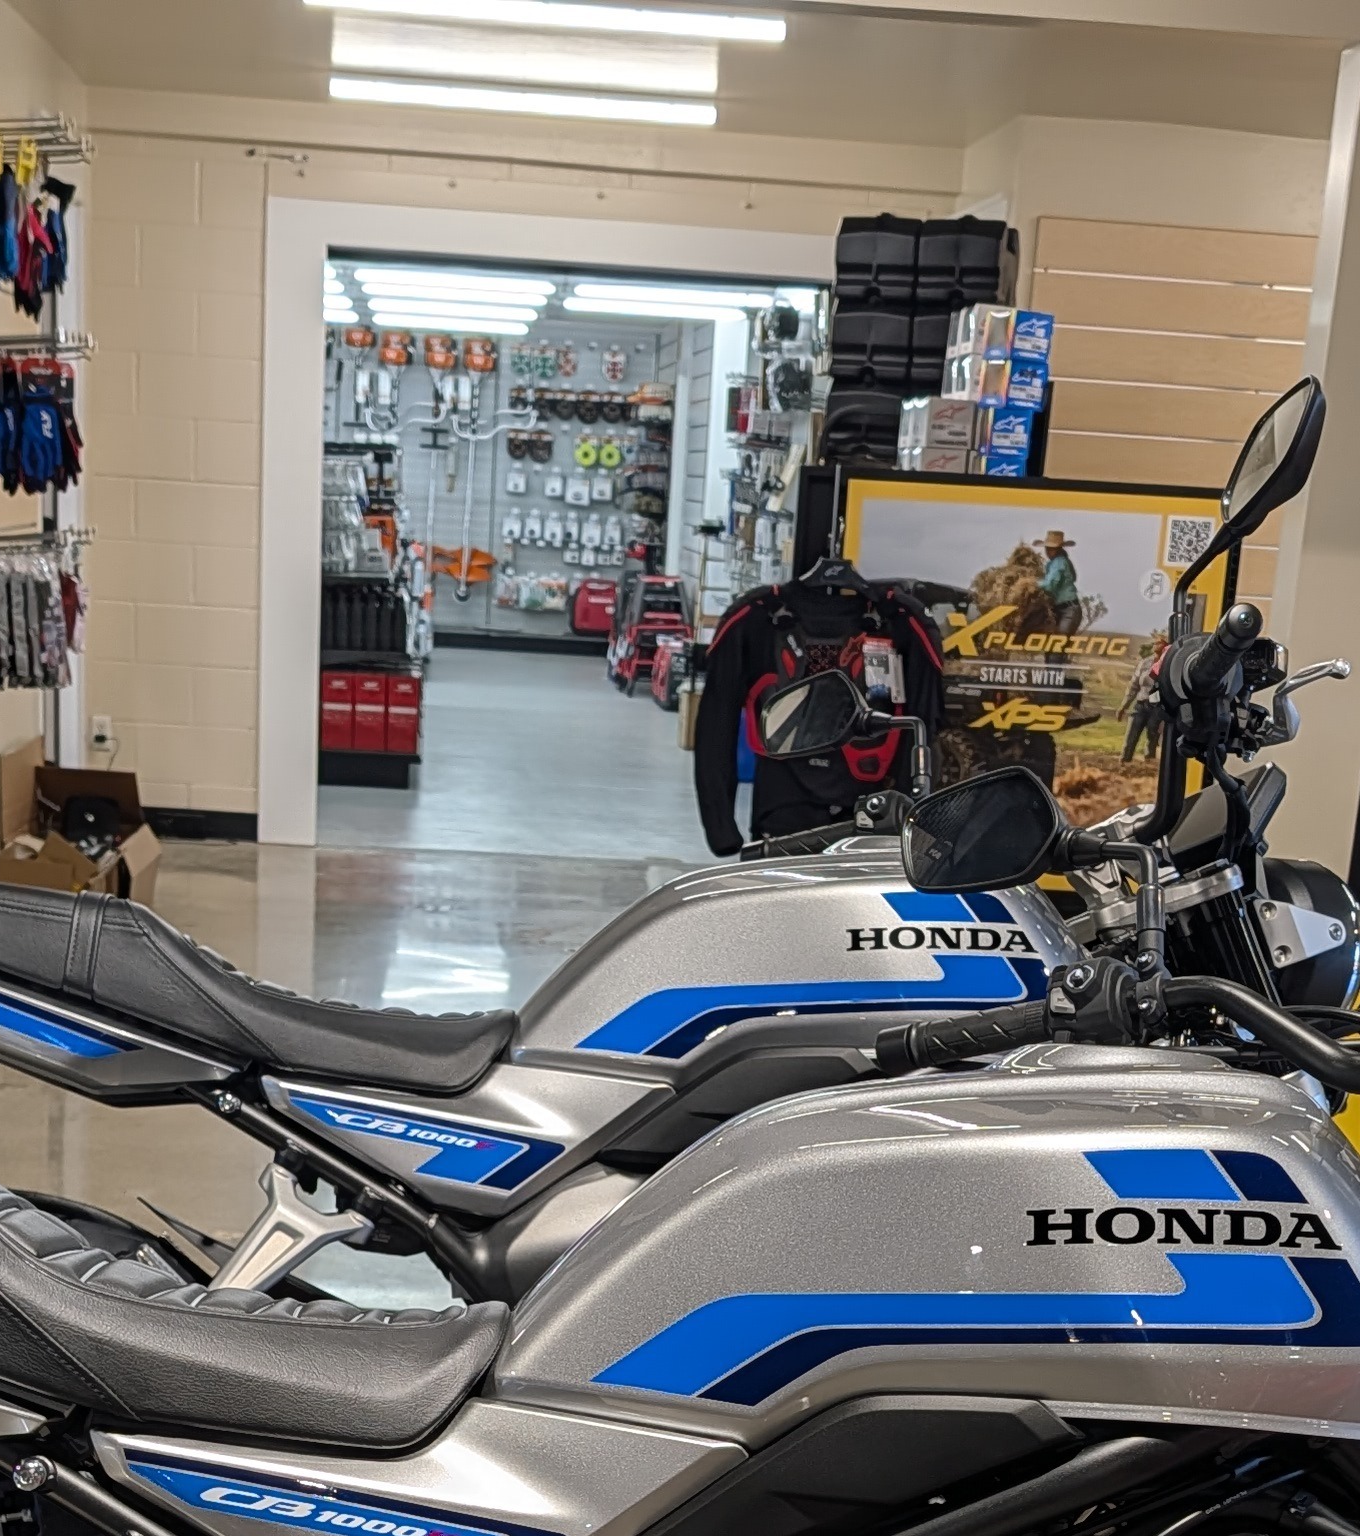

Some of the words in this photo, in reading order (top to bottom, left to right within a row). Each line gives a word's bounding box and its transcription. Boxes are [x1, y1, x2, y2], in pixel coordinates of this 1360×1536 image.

[979, 667, 1028, 684] STARTS
[1031, 669, 1066, 686] WITH
[966, 697, 1072, 732] XPS
[846, 926, 1039, 953] HONDA
[1026, 1206, 1343, 1251] HONDA
